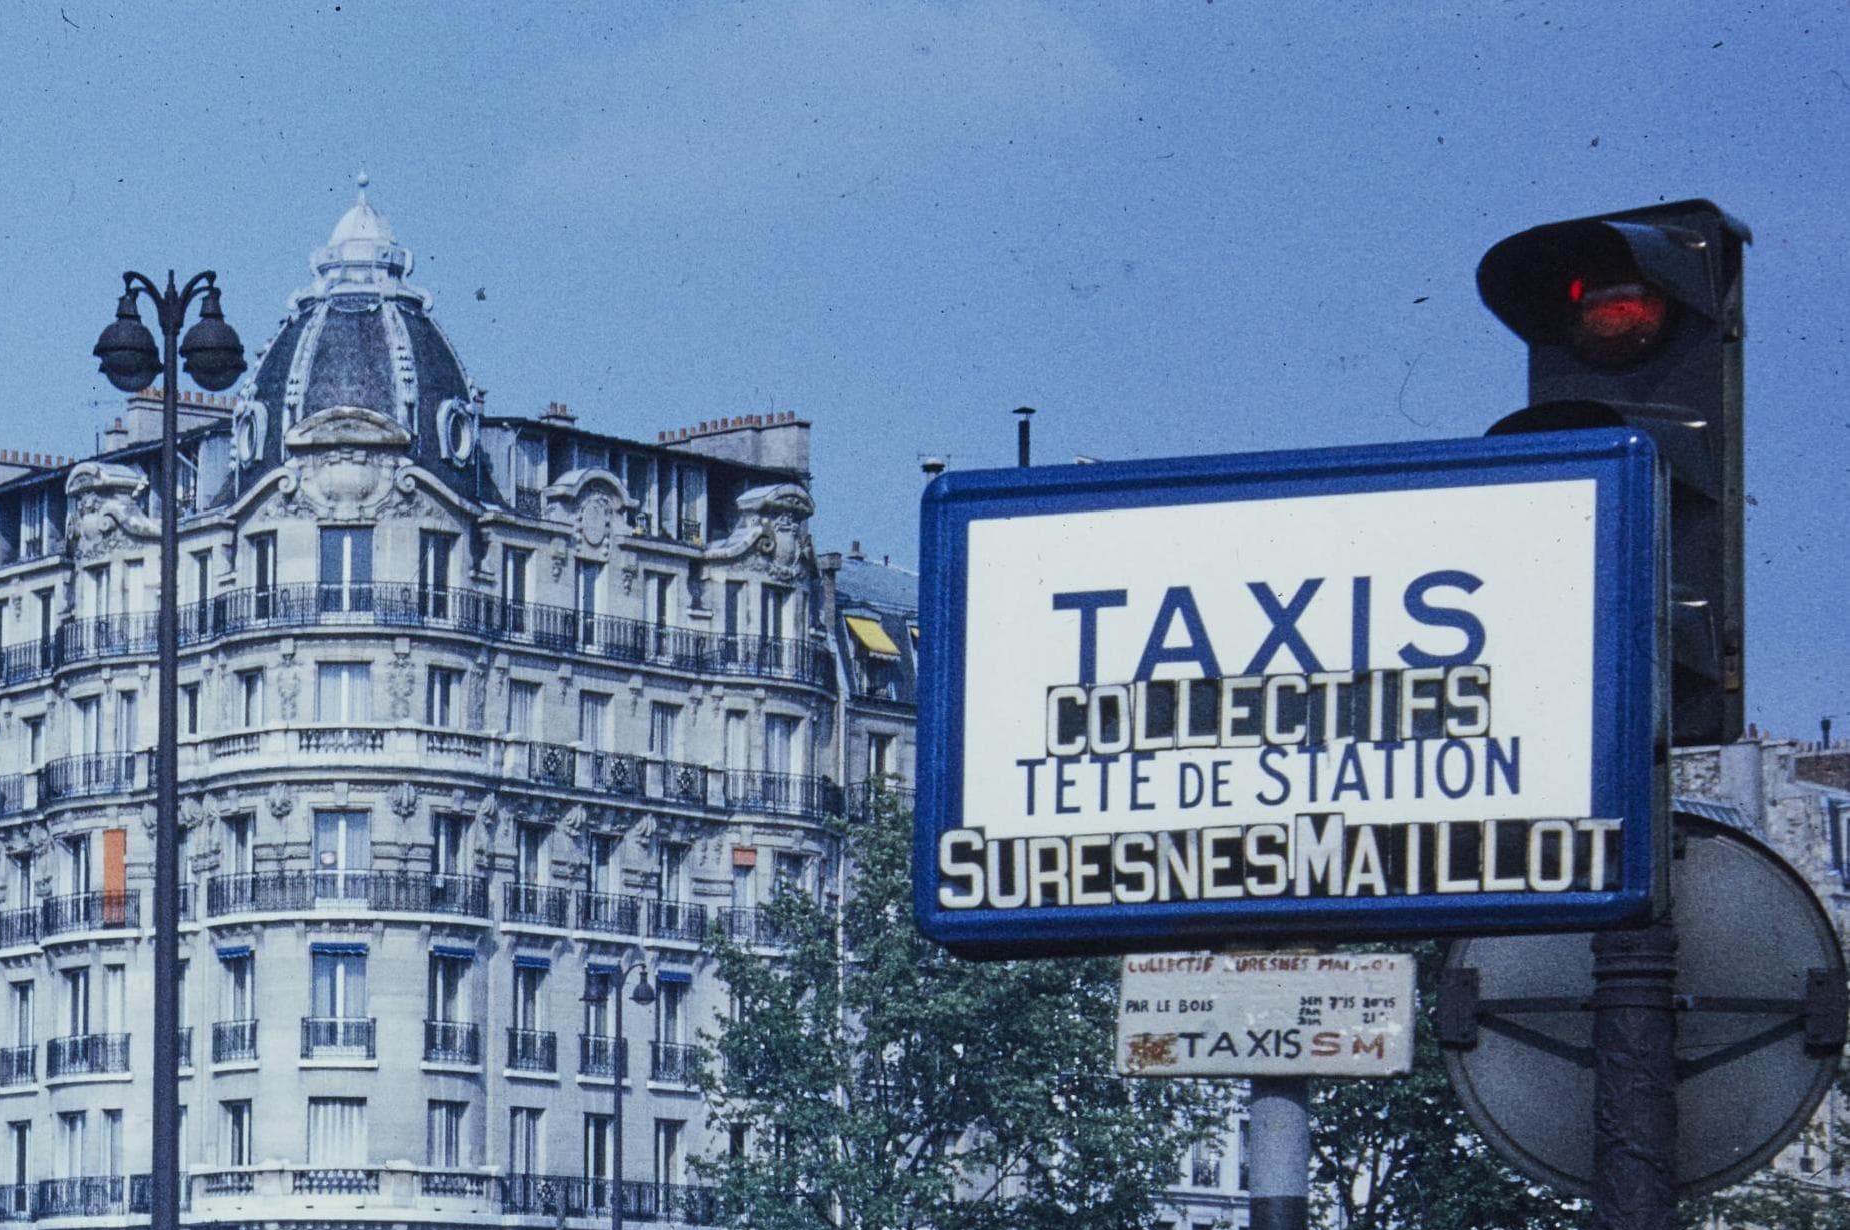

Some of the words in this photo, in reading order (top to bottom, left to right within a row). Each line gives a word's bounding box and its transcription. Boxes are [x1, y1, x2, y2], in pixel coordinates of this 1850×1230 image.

[1052, 570, 1487, 684] TAXIS
[1046, 665, 1491, 757] COLLECTIFS
[1179, 760, 1233, 808] DE
[1256, 736, 1521, 806] STATION
[1125, 999, 1149, 1013] PAR
[1156, 999, 1170, 1012] LE
[1178, 999, 1214, 1013] BOIS
[1179, 1029, 1302, 1059] TAXIS
